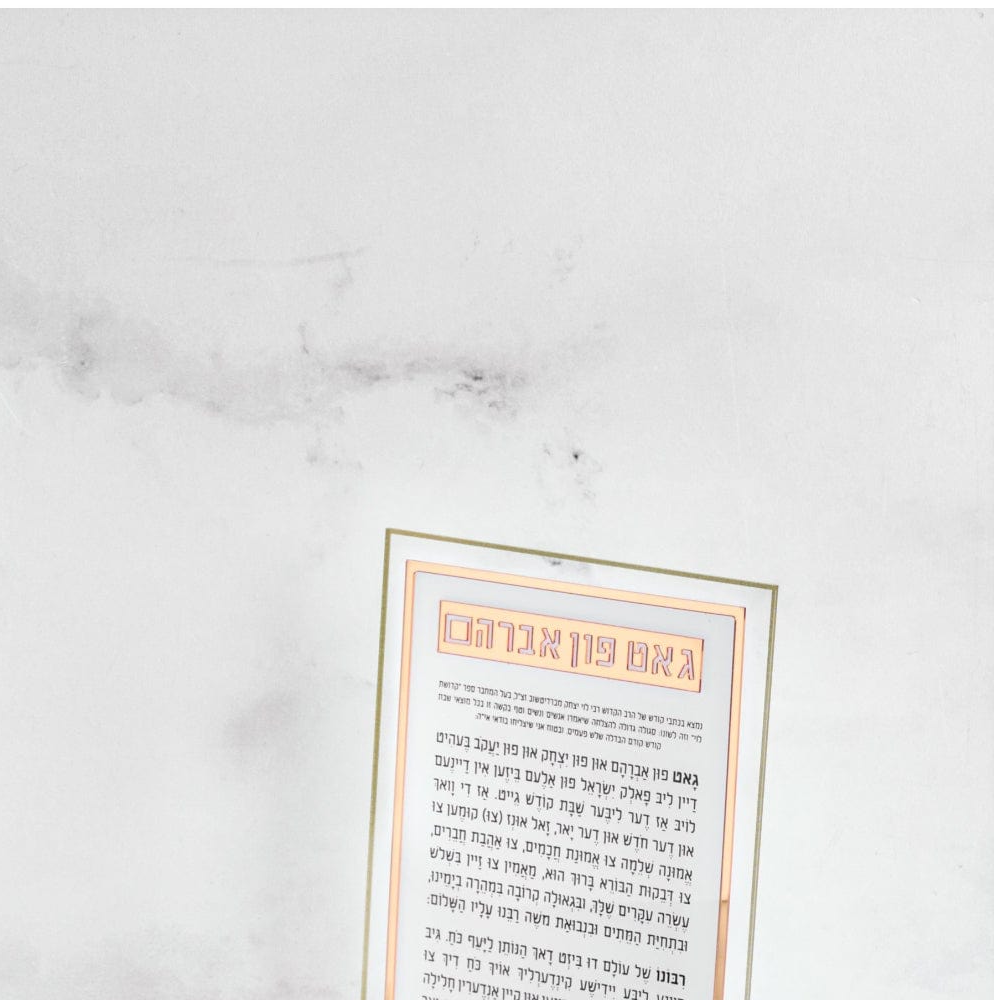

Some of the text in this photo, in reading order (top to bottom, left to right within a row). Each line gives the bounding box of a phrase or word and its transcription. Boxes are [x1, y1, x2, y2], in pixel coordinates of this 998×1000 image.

[443, 612, 696, 681] גאט פון אברהם
